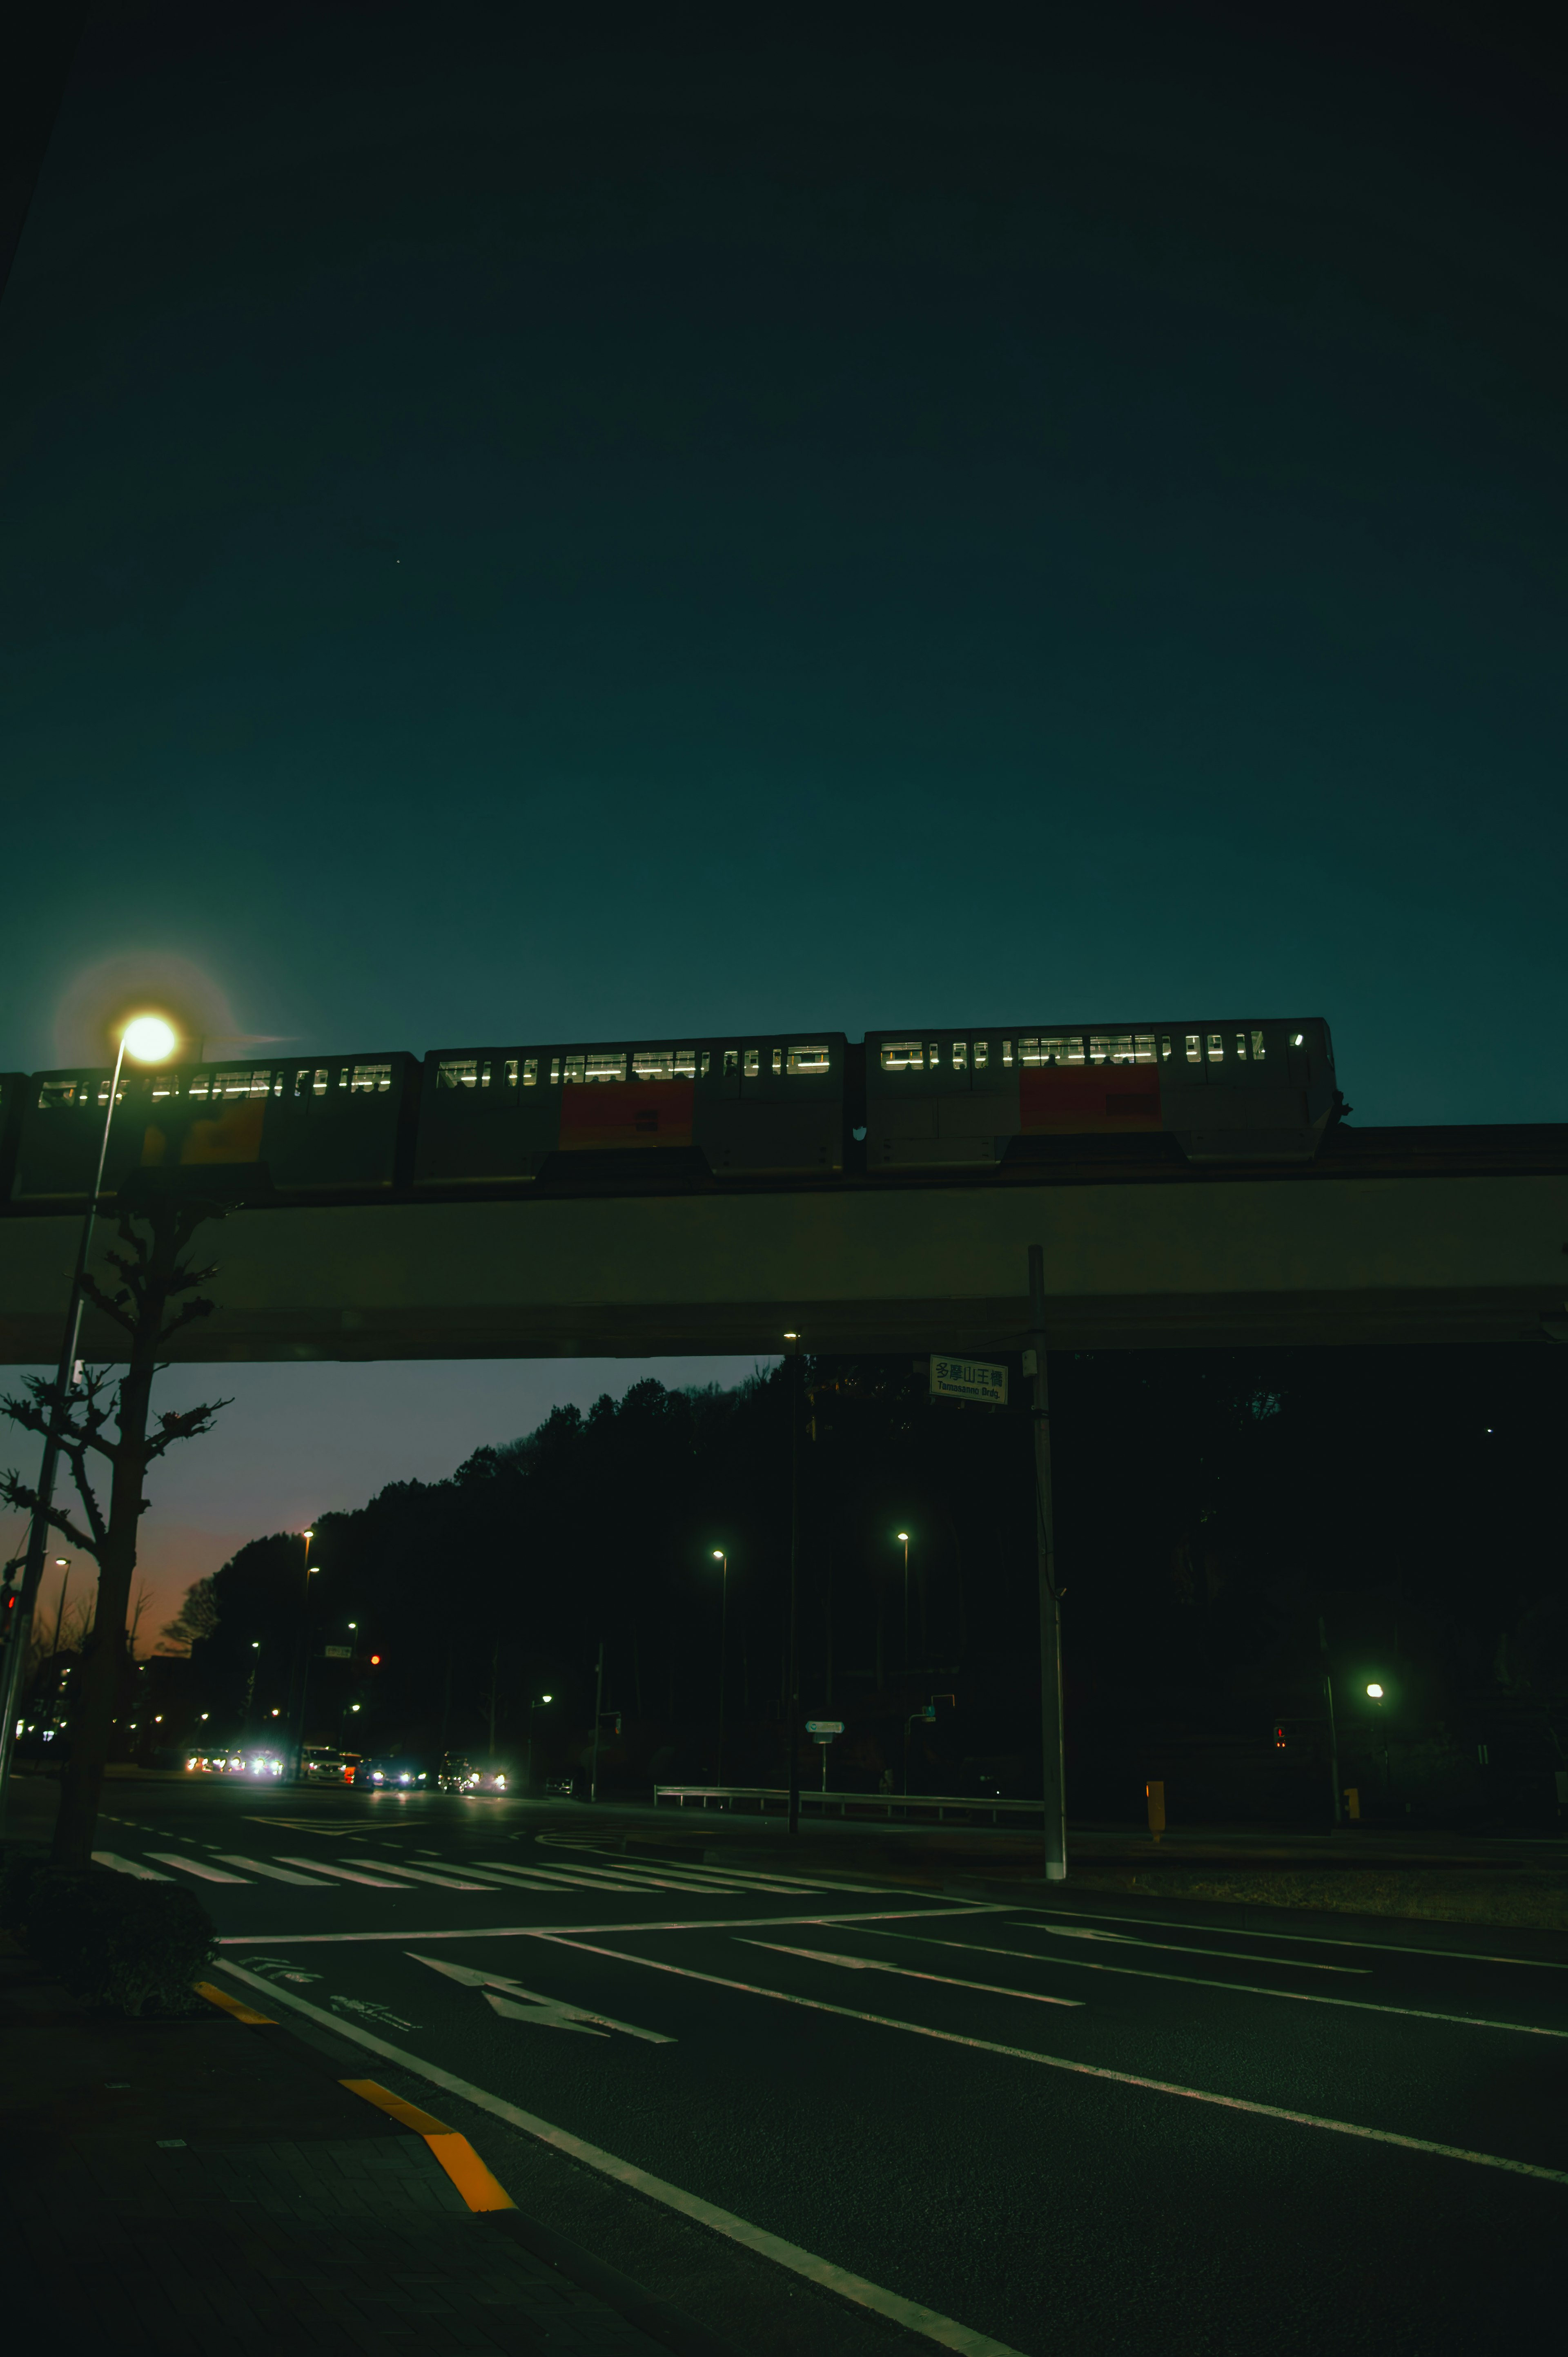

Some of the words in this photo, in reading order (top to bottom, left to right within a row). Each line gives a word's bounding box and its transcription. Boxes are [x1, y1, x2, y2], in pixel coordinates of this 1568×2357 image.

[936, 1362, 1002, 1387] 多摩山王橋
[938, 1380, 979, 1395] Tamasanno
